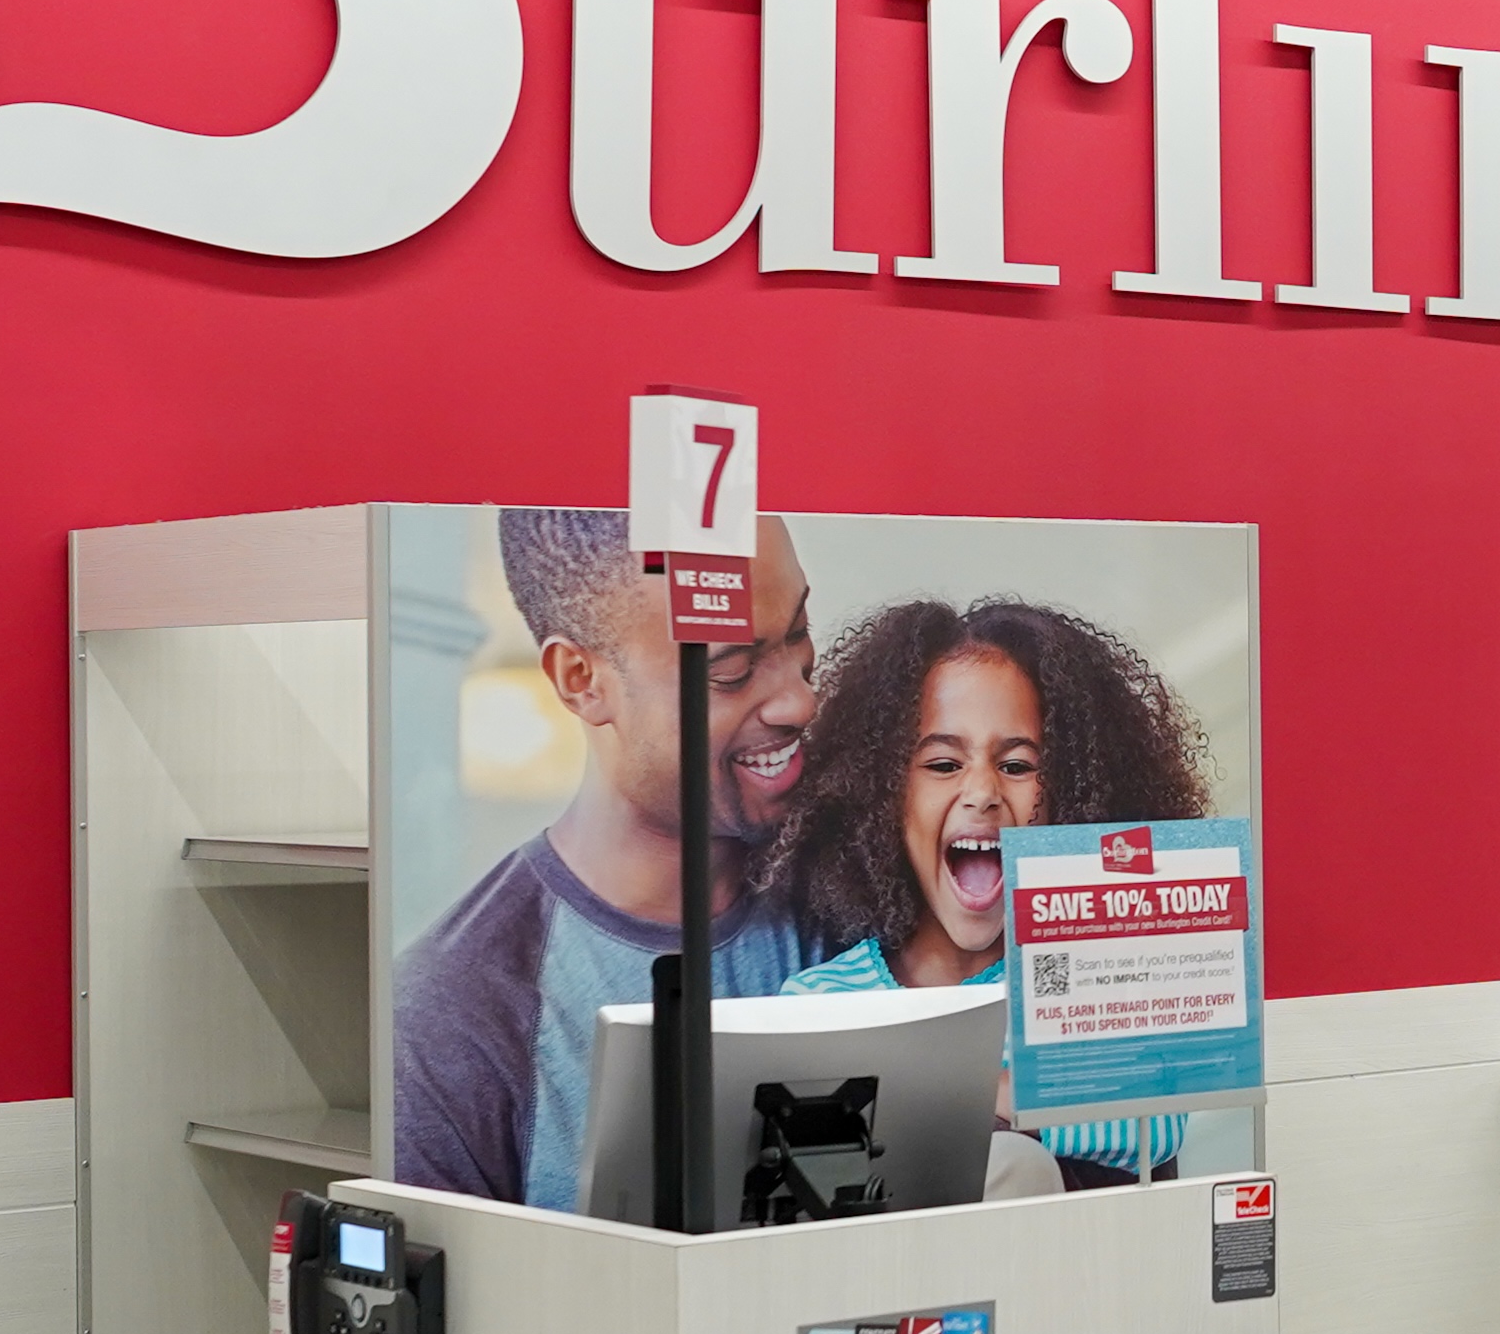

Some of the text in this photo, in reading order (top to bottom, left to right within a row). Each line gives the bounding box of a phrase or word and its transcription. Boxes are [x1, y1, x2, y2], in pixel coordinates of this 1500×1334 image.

[693, 424, 734, 528] 7
[674, 570, 743, 590] WE CHECK
[692, 594, 730, 611] BILLS
[1032, 884, 1231, 923] SAVE 10% TODAY
[1075, 950, 1234, 972] Scan to see prequalified
[1096, 972, 1150, 985] NO IMPACT
[1036, 993, 1235, 1021] PLUS, EARN 1 REWARD POINT FOR EVERY
[1061, 1012, 1177, 1035] $1 YOU SPEND ON YOUR
